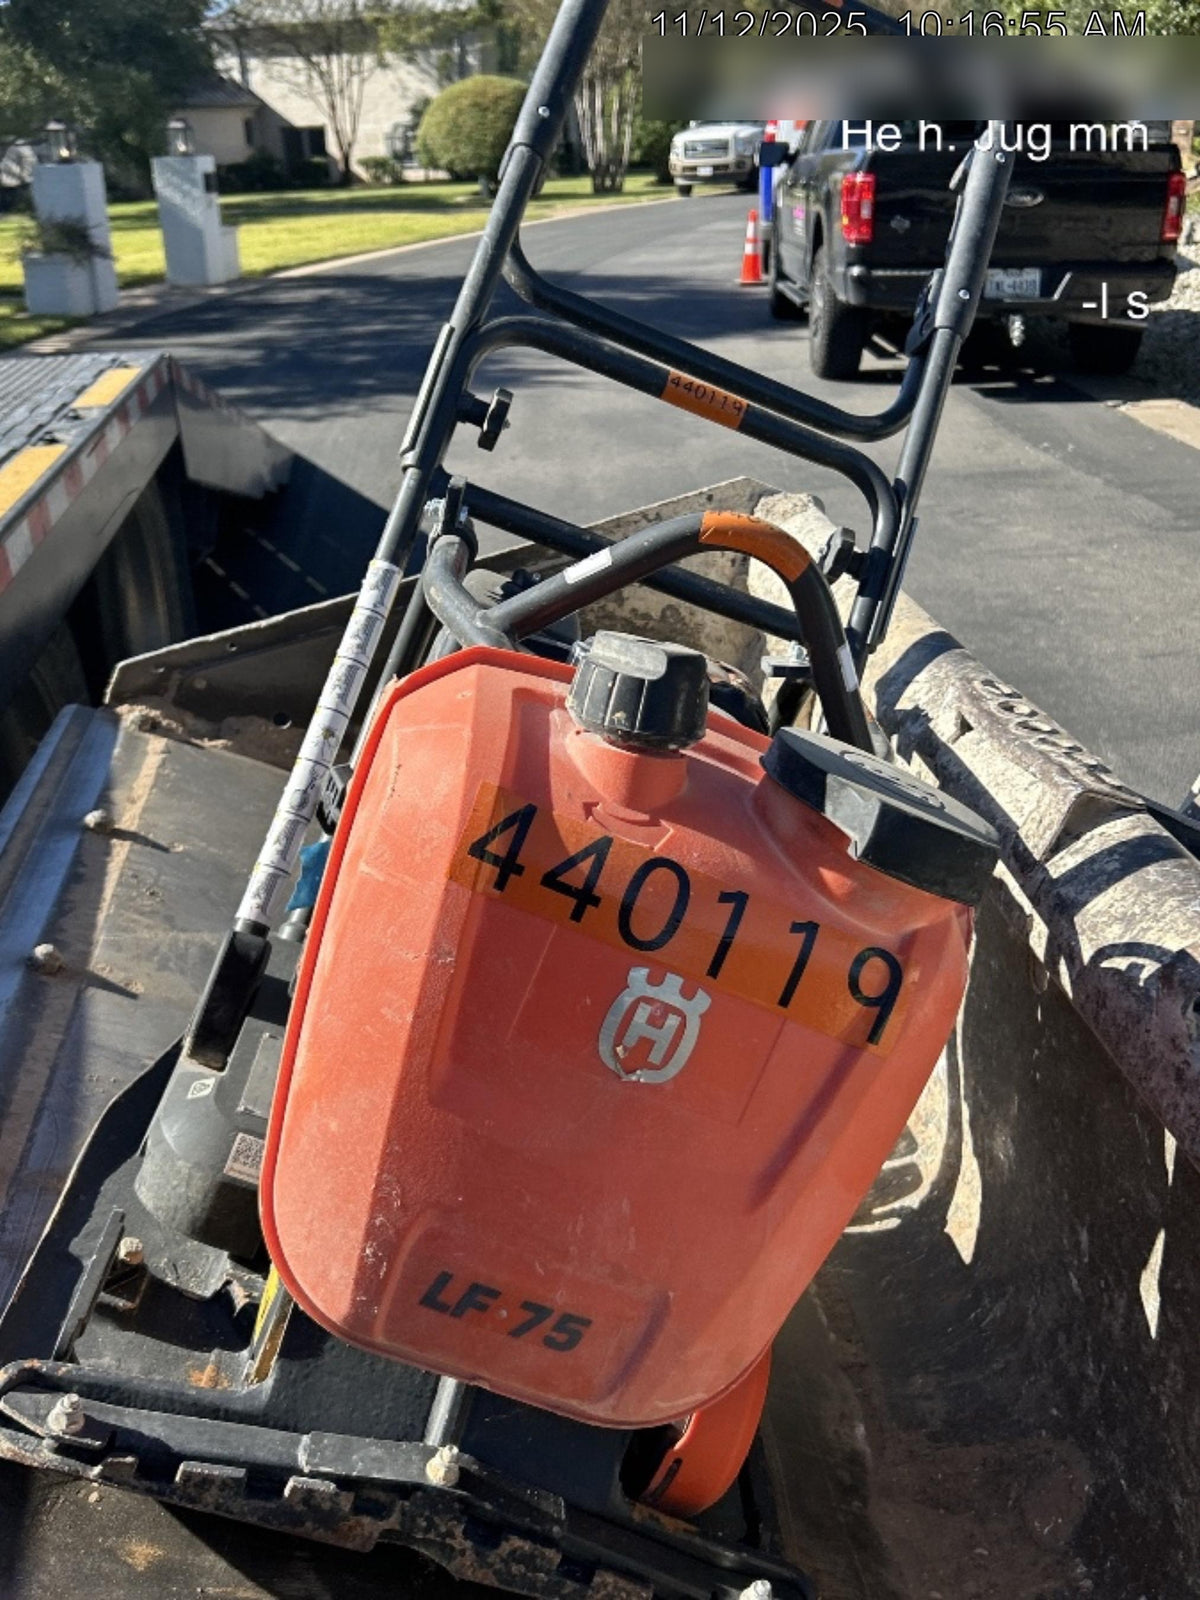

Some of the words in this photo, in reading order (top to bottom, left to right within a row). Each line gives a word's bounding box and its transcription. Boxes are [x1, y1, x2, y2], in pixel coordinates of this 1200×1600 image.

[670, 376, 743, 417] 440119
[467, 803, 902, 1046] 440119
[419, 1271, 502, 1318] LF
[508, 1301, 593, 1352] 75
